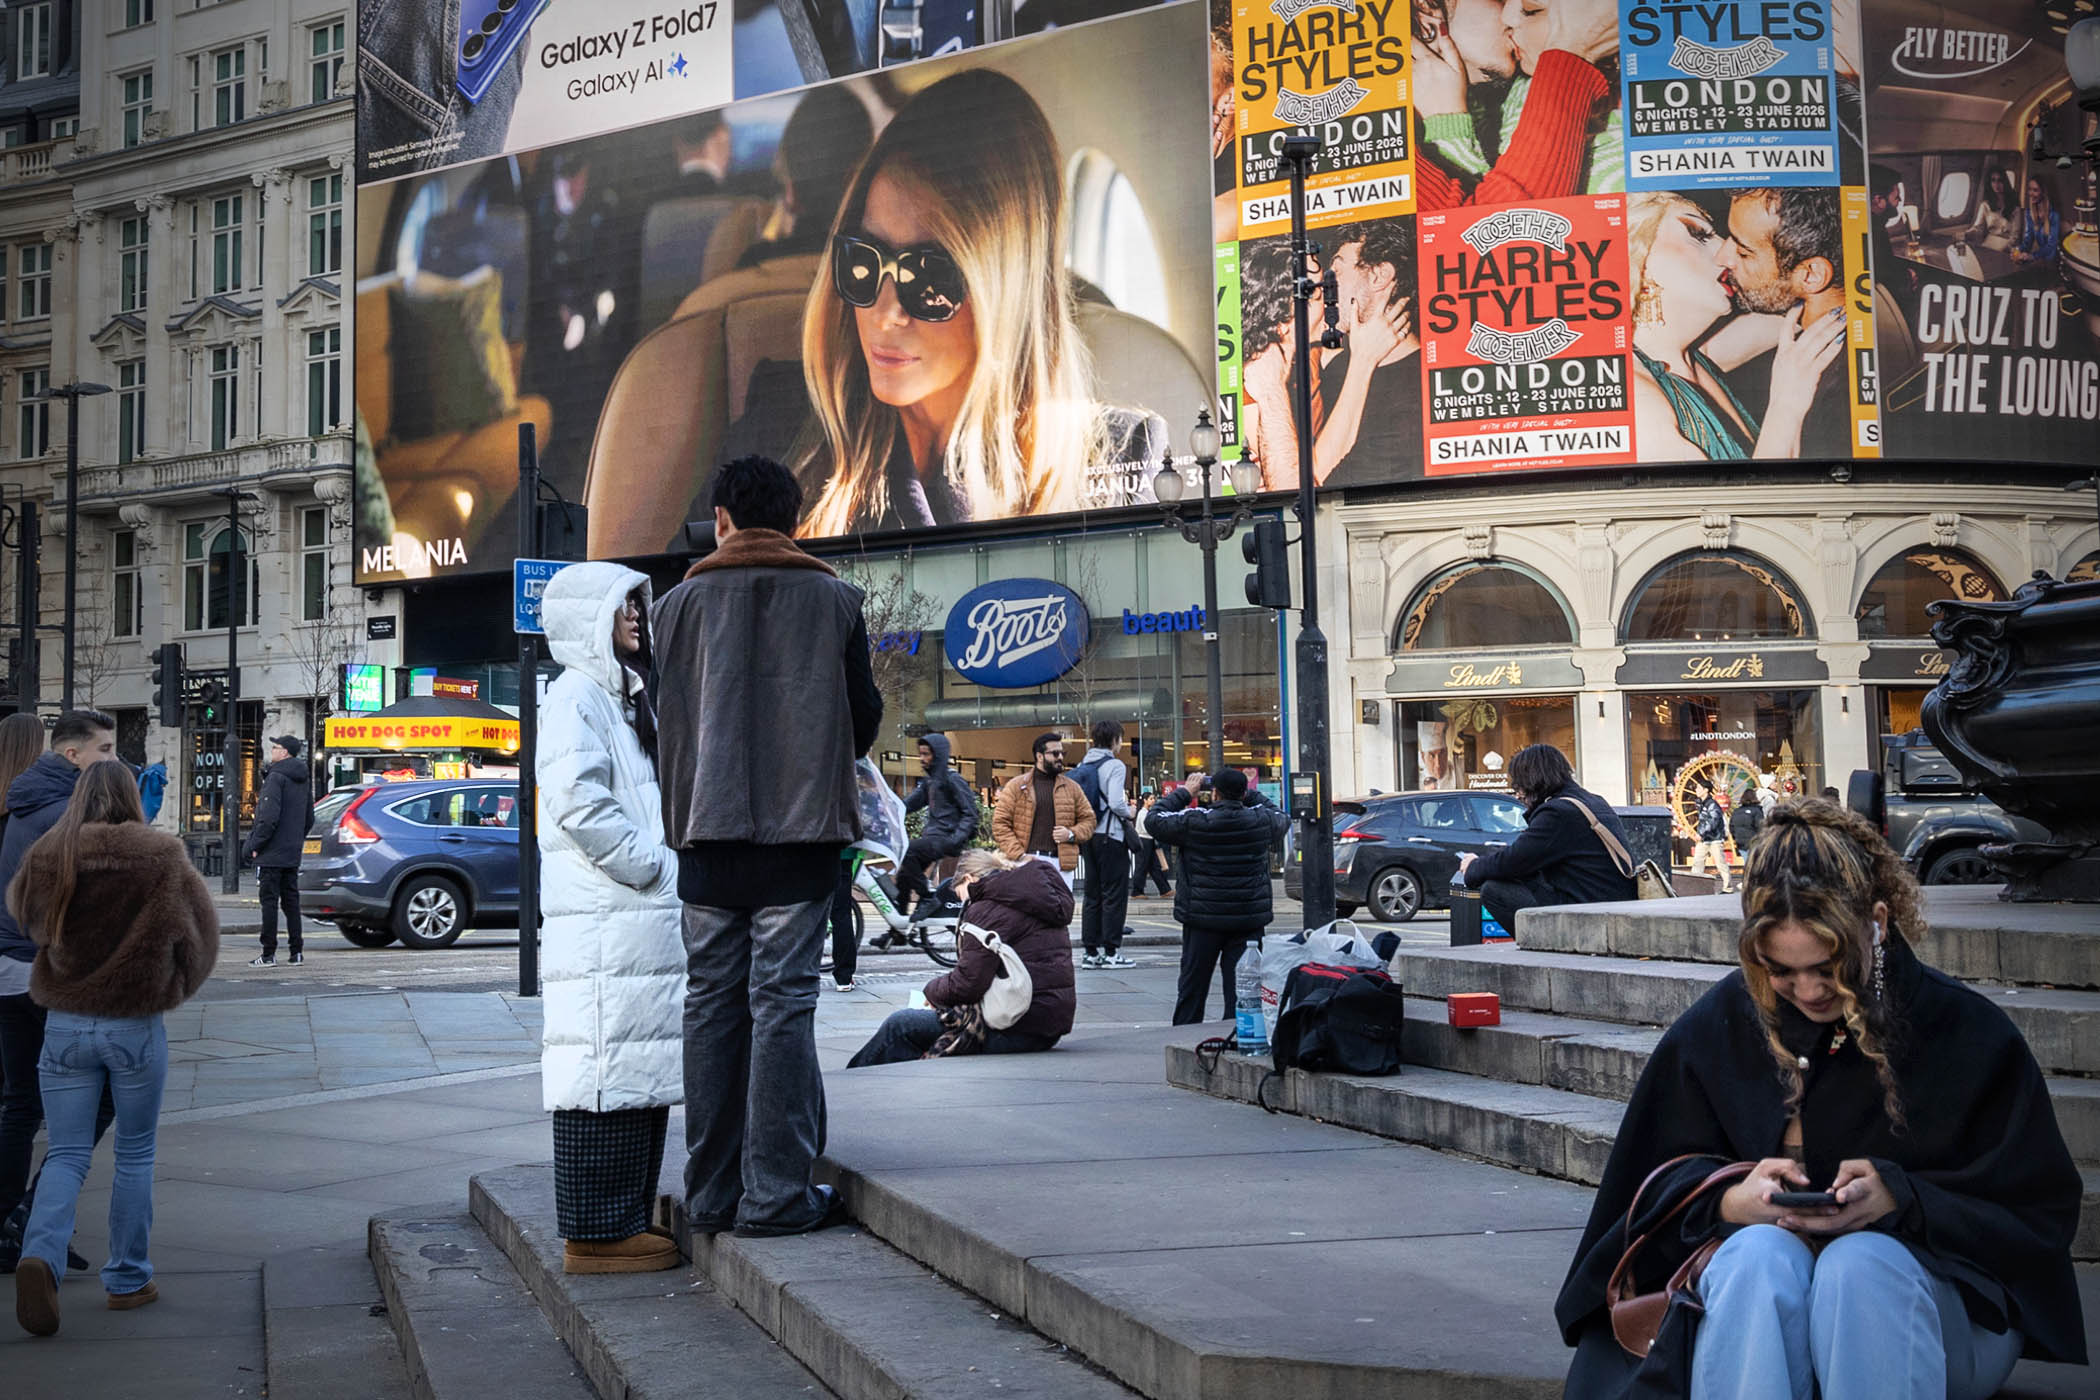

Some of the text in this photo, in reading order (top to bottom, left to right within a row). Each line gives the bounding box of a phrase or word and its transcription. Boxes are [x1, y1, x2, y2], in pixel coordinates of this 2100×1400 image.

[540, 1, 718, 69] Galaxy Z Fold7
[1248, 0, 1393, 62] HARRY
[1628, 2, 1825, 46] STYLES
[1669, 36, 1787, 80] TOGETHER
[1903, 26, 2009, 64] FLY BETTER
[566, 59, 664, 101] Galaxy AI
[1241, 36, 1405, 102] STYLES
[1274, 78, 1368, 125] TOGETHER
[1635, 78, 1824, 109] LONDON
[1634, 110, 1643, 122] 6
[1646, 107, 1698, 121] NIGHTS
[1710, 106, 1726, 118] 12
[1737, 105, 1753, 117] 23
[1756, 105, 1793, 116] JUNE
[1795, 105, 1826, 116] 2026
[1634, 117, 1826, 133] WEMBLEY STADIUM
[1245, 162, 1253, 173] 6
[1327, 146, 1340, 158] 23
[1342, 140, 1374, 155] JUNE
[1376, 136, 1404, 149] 2026
[1332, 147, 1404, 169] STADIUM
[1639, 149, 1825, 172] SHANIA TWAIN
[1249, 193, 1326, 220] SHAIA
[1333, 179, 1403, 206] TWAIN
[1464, 209, 1571, 255] TOGETHER
[1436, 239, 1612, 293] HARRY
[1428, 280, 1622, 334] STYLES
[1918, 283, 2012, 346] CRUZ
[2021, 288, 2059, 350] TO
[1466, 319, 1581, 364] TOGETHER
[1434, 357, 1620, 397] LONDON
[1923, 352, 2100, 420] THE LOUNG
[1433, 397, 1442, 409] 6
[1444, 392, 1494, 408] NIGHTS
[1505, 391, 1520, 402] 12
[1531, 389, 1547, 401] 23
[1549, 386, 1586, 400] JUNE
[1589, 384, 1622, 397] 2026
[1433, 397, 1622, 421] WEMBLEY STADIUM
[1438, 430, 1621, 460] SHANIA TWAIN
[362, 537, 468, 574] MELANIA
[523, 564, 546, 576] BUS
[957, 593, 1067, 670] Boots
[1122, 604, 1206, 635] beaut
[1443, 663, 1507, 688] Lindt
[1680, 656, 1749, 680] Lindt
[1914, 652, 1950, 675] Lin
[333, 725, 452, 738] HOT DOG SPOT
[482, 726, 519, 740] HOT DOG
[1690, 731, 1757, 741] #LINDTLONDON
[196, 752, 224, 767] NOW
[195, 774, 224, 789] OPE
[1468, 779, 1509, 789] Handmade
